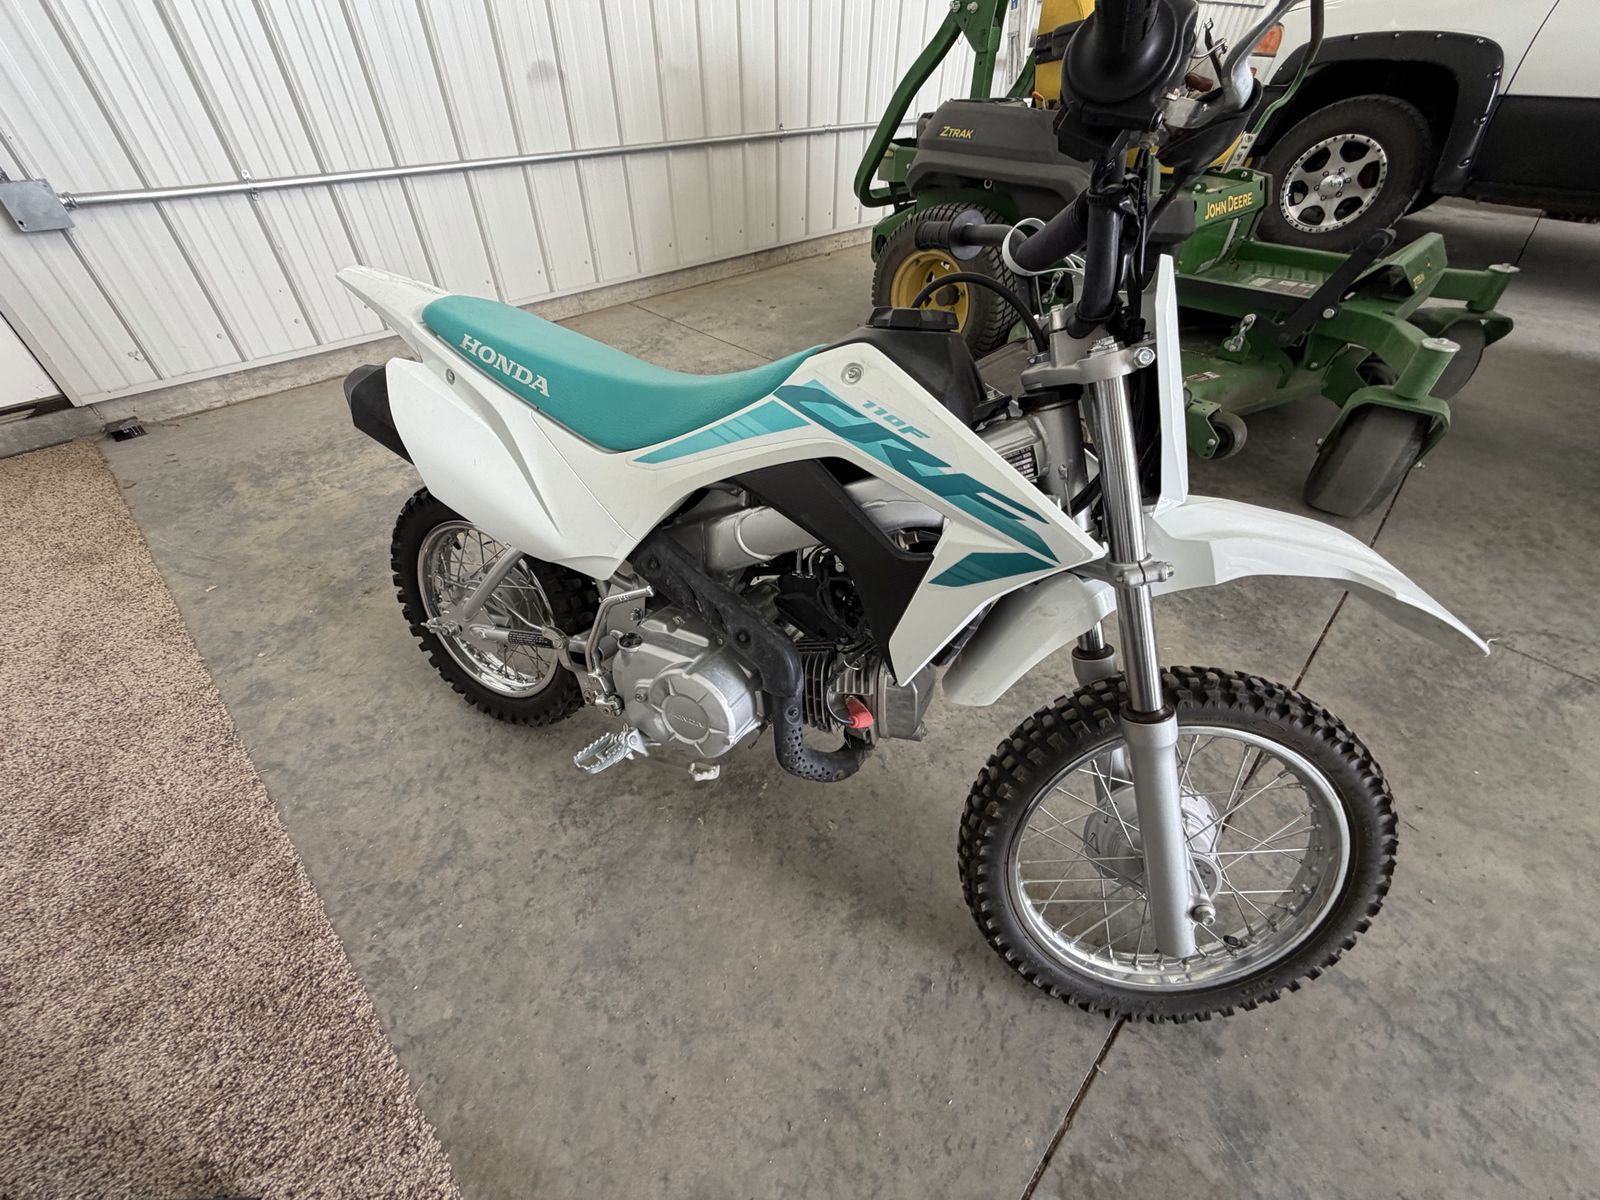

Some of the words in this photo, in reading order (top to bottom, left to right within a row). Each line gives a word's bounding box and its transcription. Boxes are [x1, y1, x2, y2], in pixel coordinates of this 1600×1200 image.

[940, 125, 974, 140] ZTRAK
[1204, 201, 1228, 220] JOHN
[1227, 192, 1253, 212] DEERE
[459, 333, 551, 398] HONDA
[862, 399, 931, 439] 110F
[773, 383, 1051, 526] CRF
[669, 710, 706, 730] ONDA
